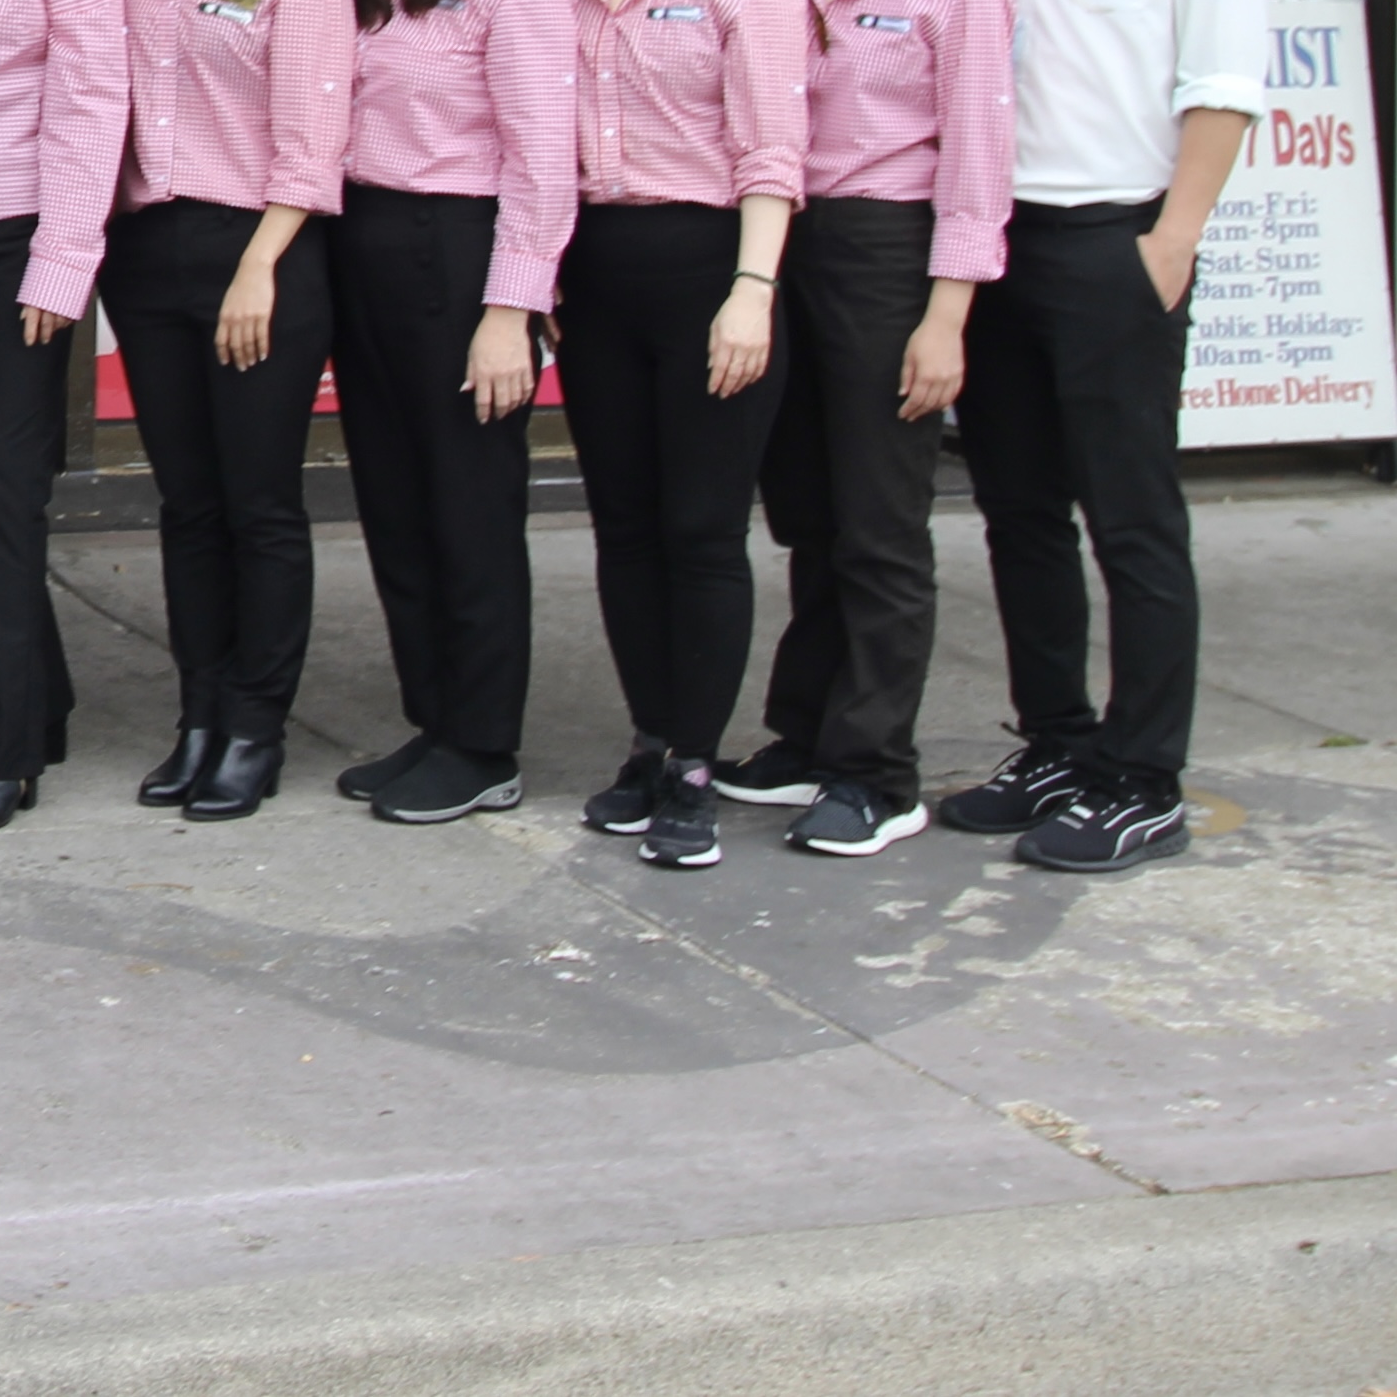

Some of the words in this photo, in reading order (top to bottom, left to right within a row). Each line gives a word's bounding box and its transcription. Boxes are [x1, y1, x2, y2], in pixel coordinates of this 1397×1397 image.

[1271, 108, 1356, 169] Days
[1203, 218, 1321, 245] am-8pm
[1198, 247, 1322, 275] Sat-Sun:
[1195, 276, 1322, 303] 9am-7pm
[1198, 314, 1258, 339] ublic
[1264, 311, 1364, 338] Holiday:
[1192, 340, 1334, 369] 10am-5pm
[1179, 387, 1214, 410] ree
[1215, 377, 1281, 408] Home
[1283, 373, 1376, 411] Delivery
